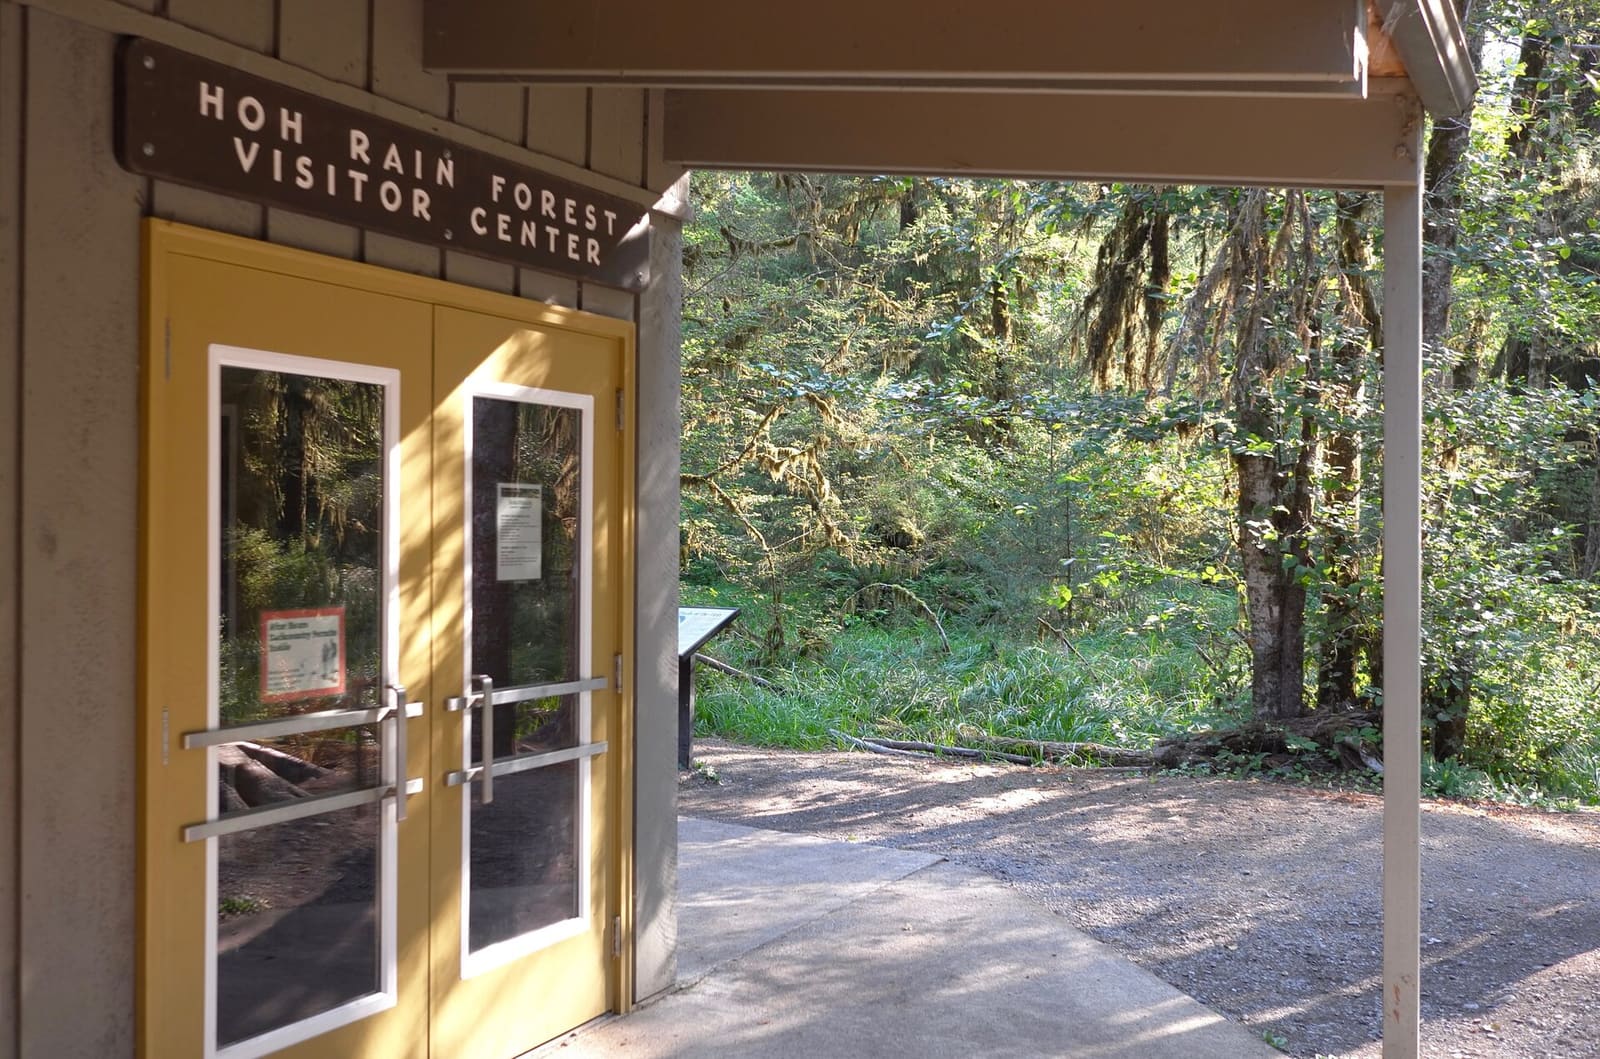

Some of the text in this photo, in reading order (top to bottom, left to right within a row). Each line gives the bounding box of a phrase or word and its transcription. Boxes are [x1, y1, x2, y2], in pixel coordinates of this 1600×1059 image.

[200, 82, 618, 236] HOH RAIN FOREST
[233, 137, 600, 266] VISITOR CENTER
